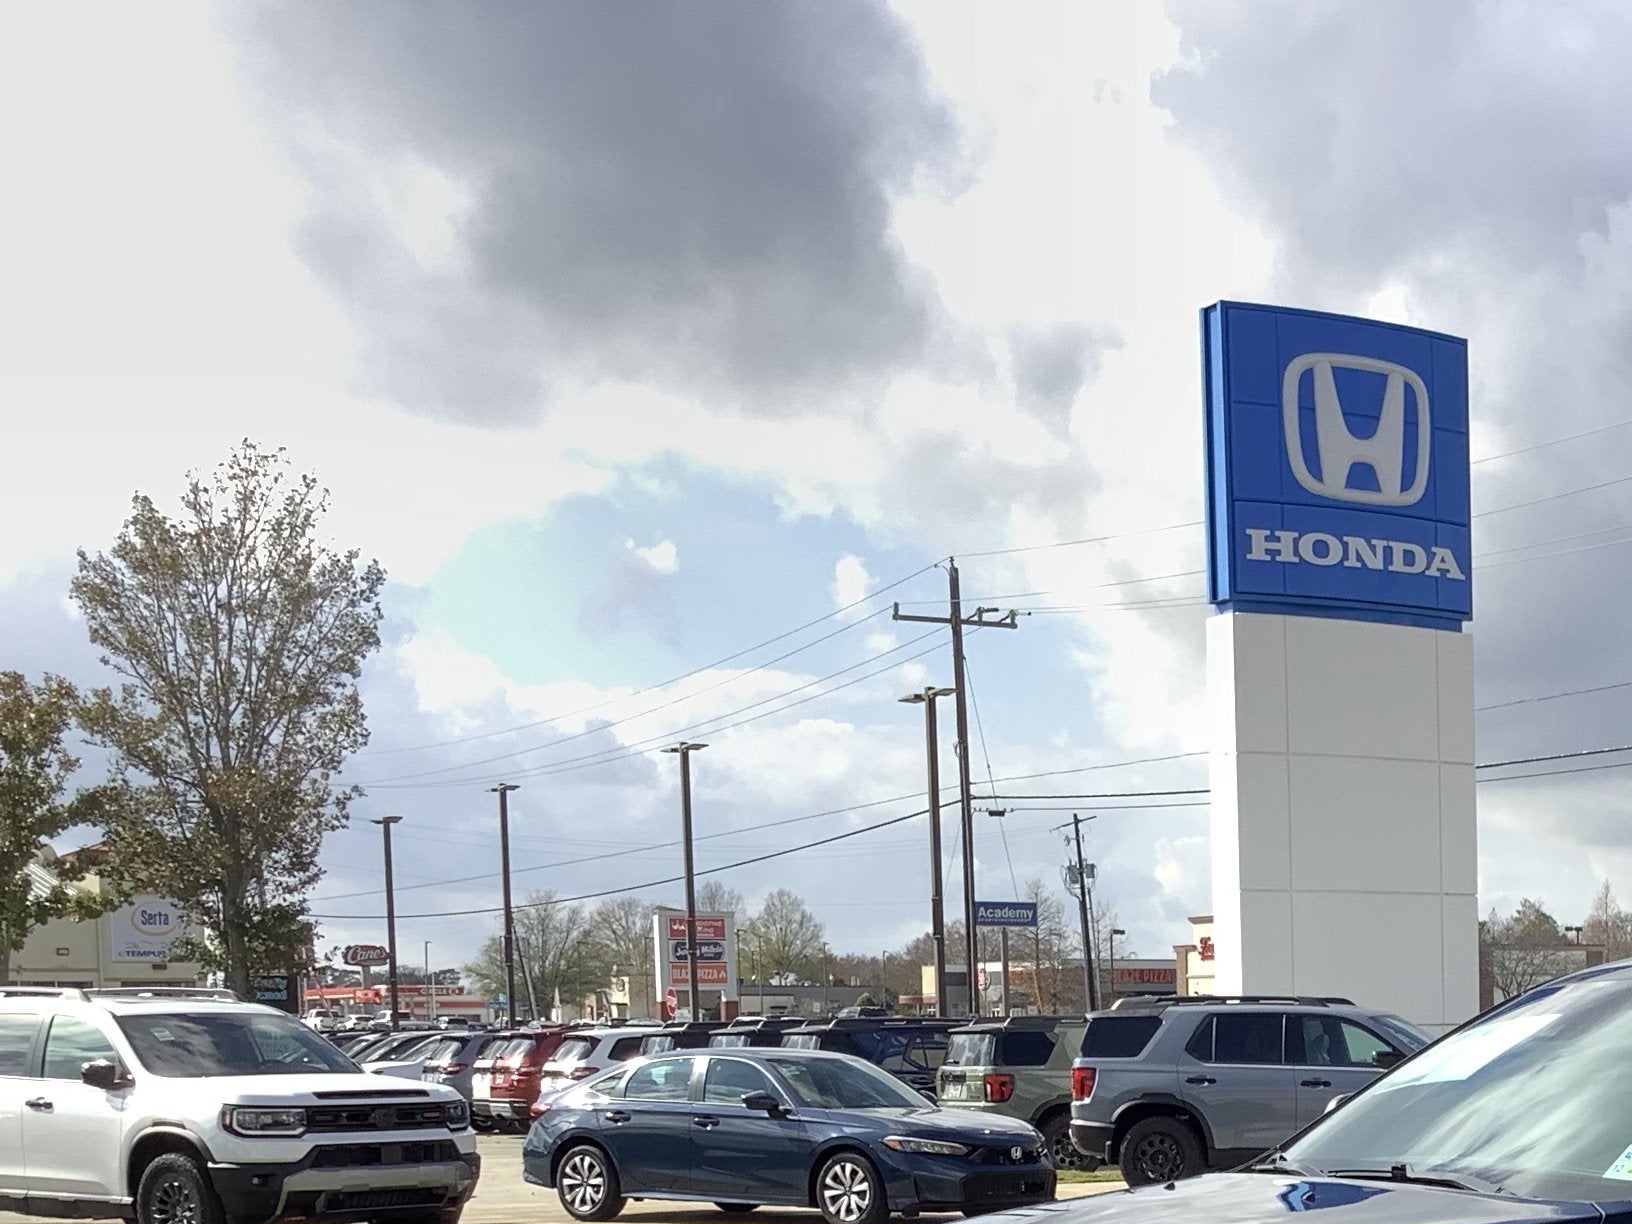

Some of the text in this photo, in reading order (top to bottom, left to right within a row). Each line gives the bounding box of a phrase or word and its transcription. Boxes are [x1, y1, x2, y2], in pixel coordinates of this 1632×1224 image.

[1245, 528, 1466, 580] HONDA
[141, 910, 169, 926] Serta
[978, 906, 1034, 921] Academy
[698, 969, 718, 980] PIZZA
